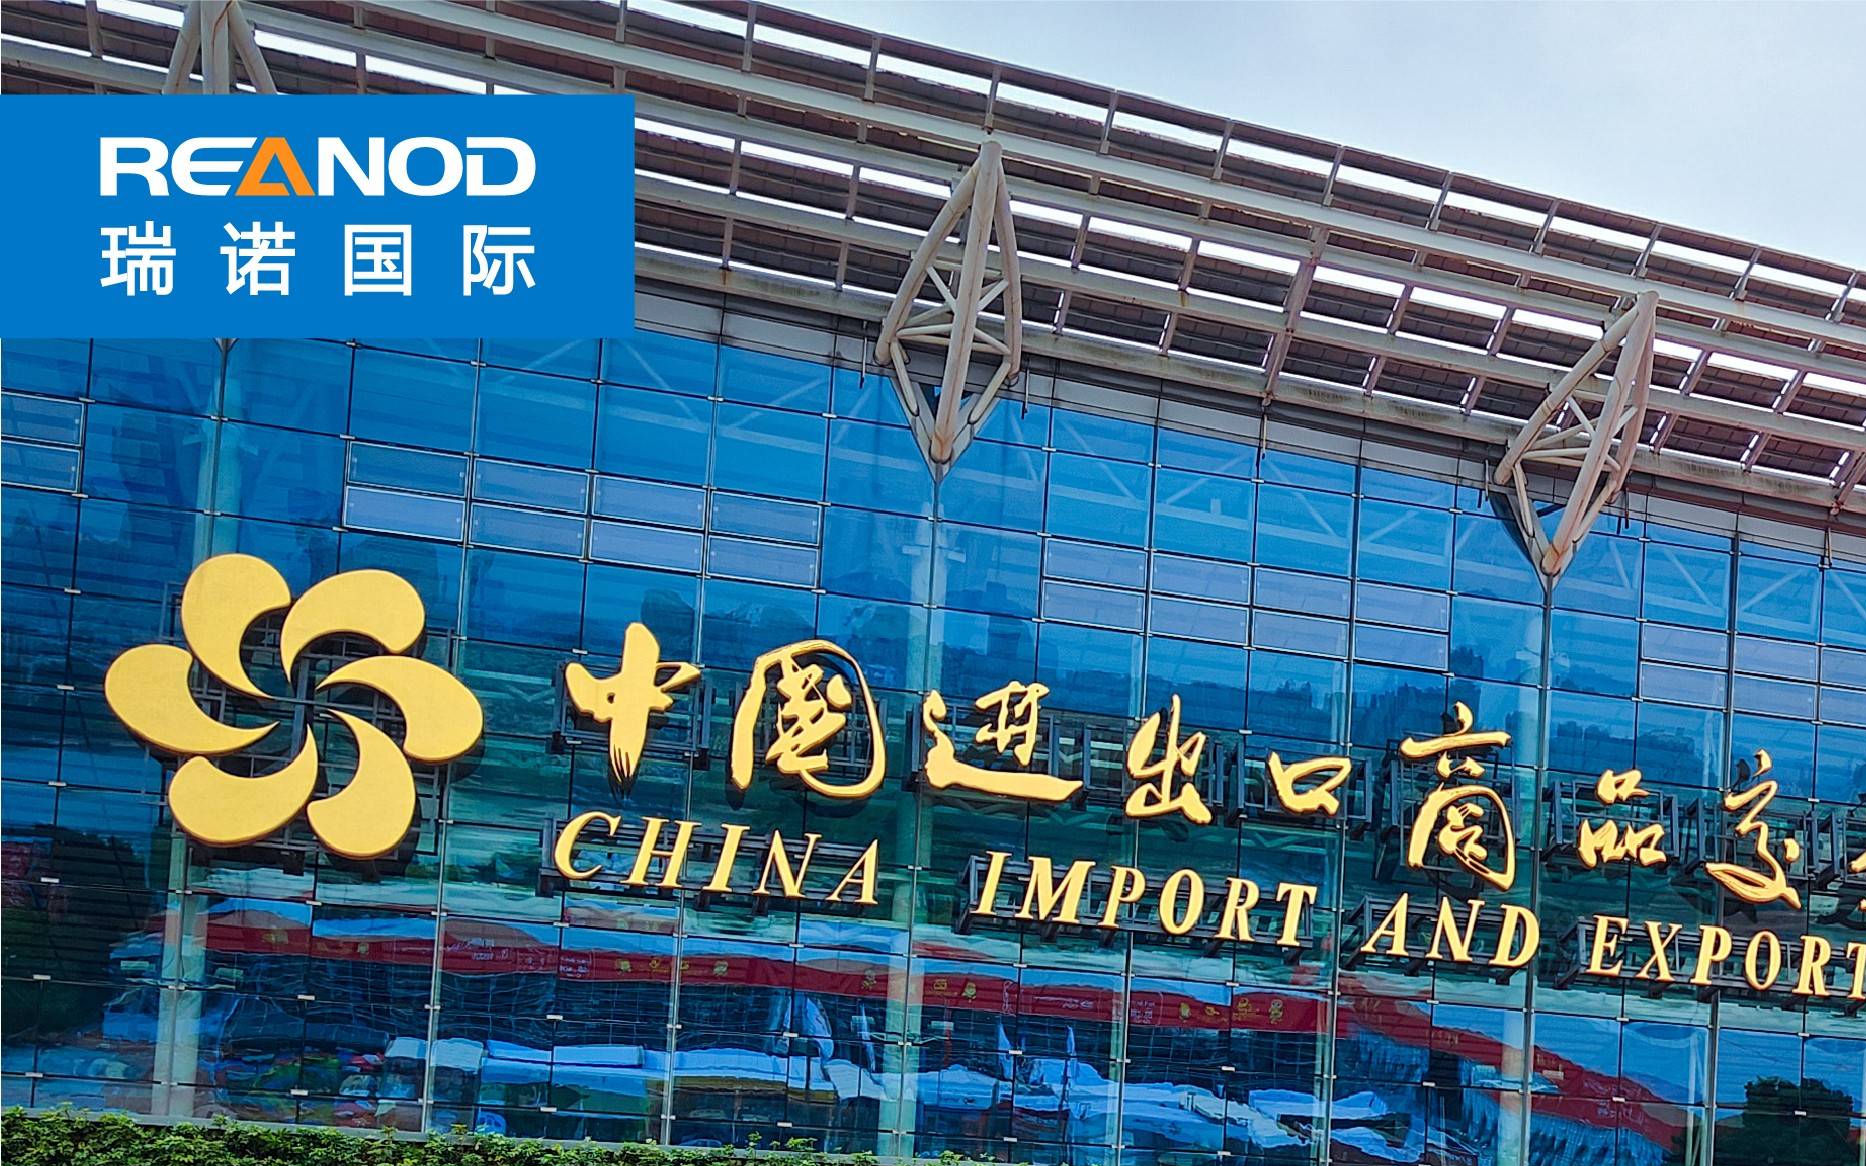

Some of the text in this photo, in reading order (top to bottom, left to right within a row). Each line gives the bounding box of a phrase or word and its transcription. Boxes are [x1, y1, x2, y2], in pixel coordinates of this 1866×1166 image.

[553, 811, 879, 905] CHINA
[974, 851, 1317, 947] IMPORT
[1360, 893, 1541, 968] AND
